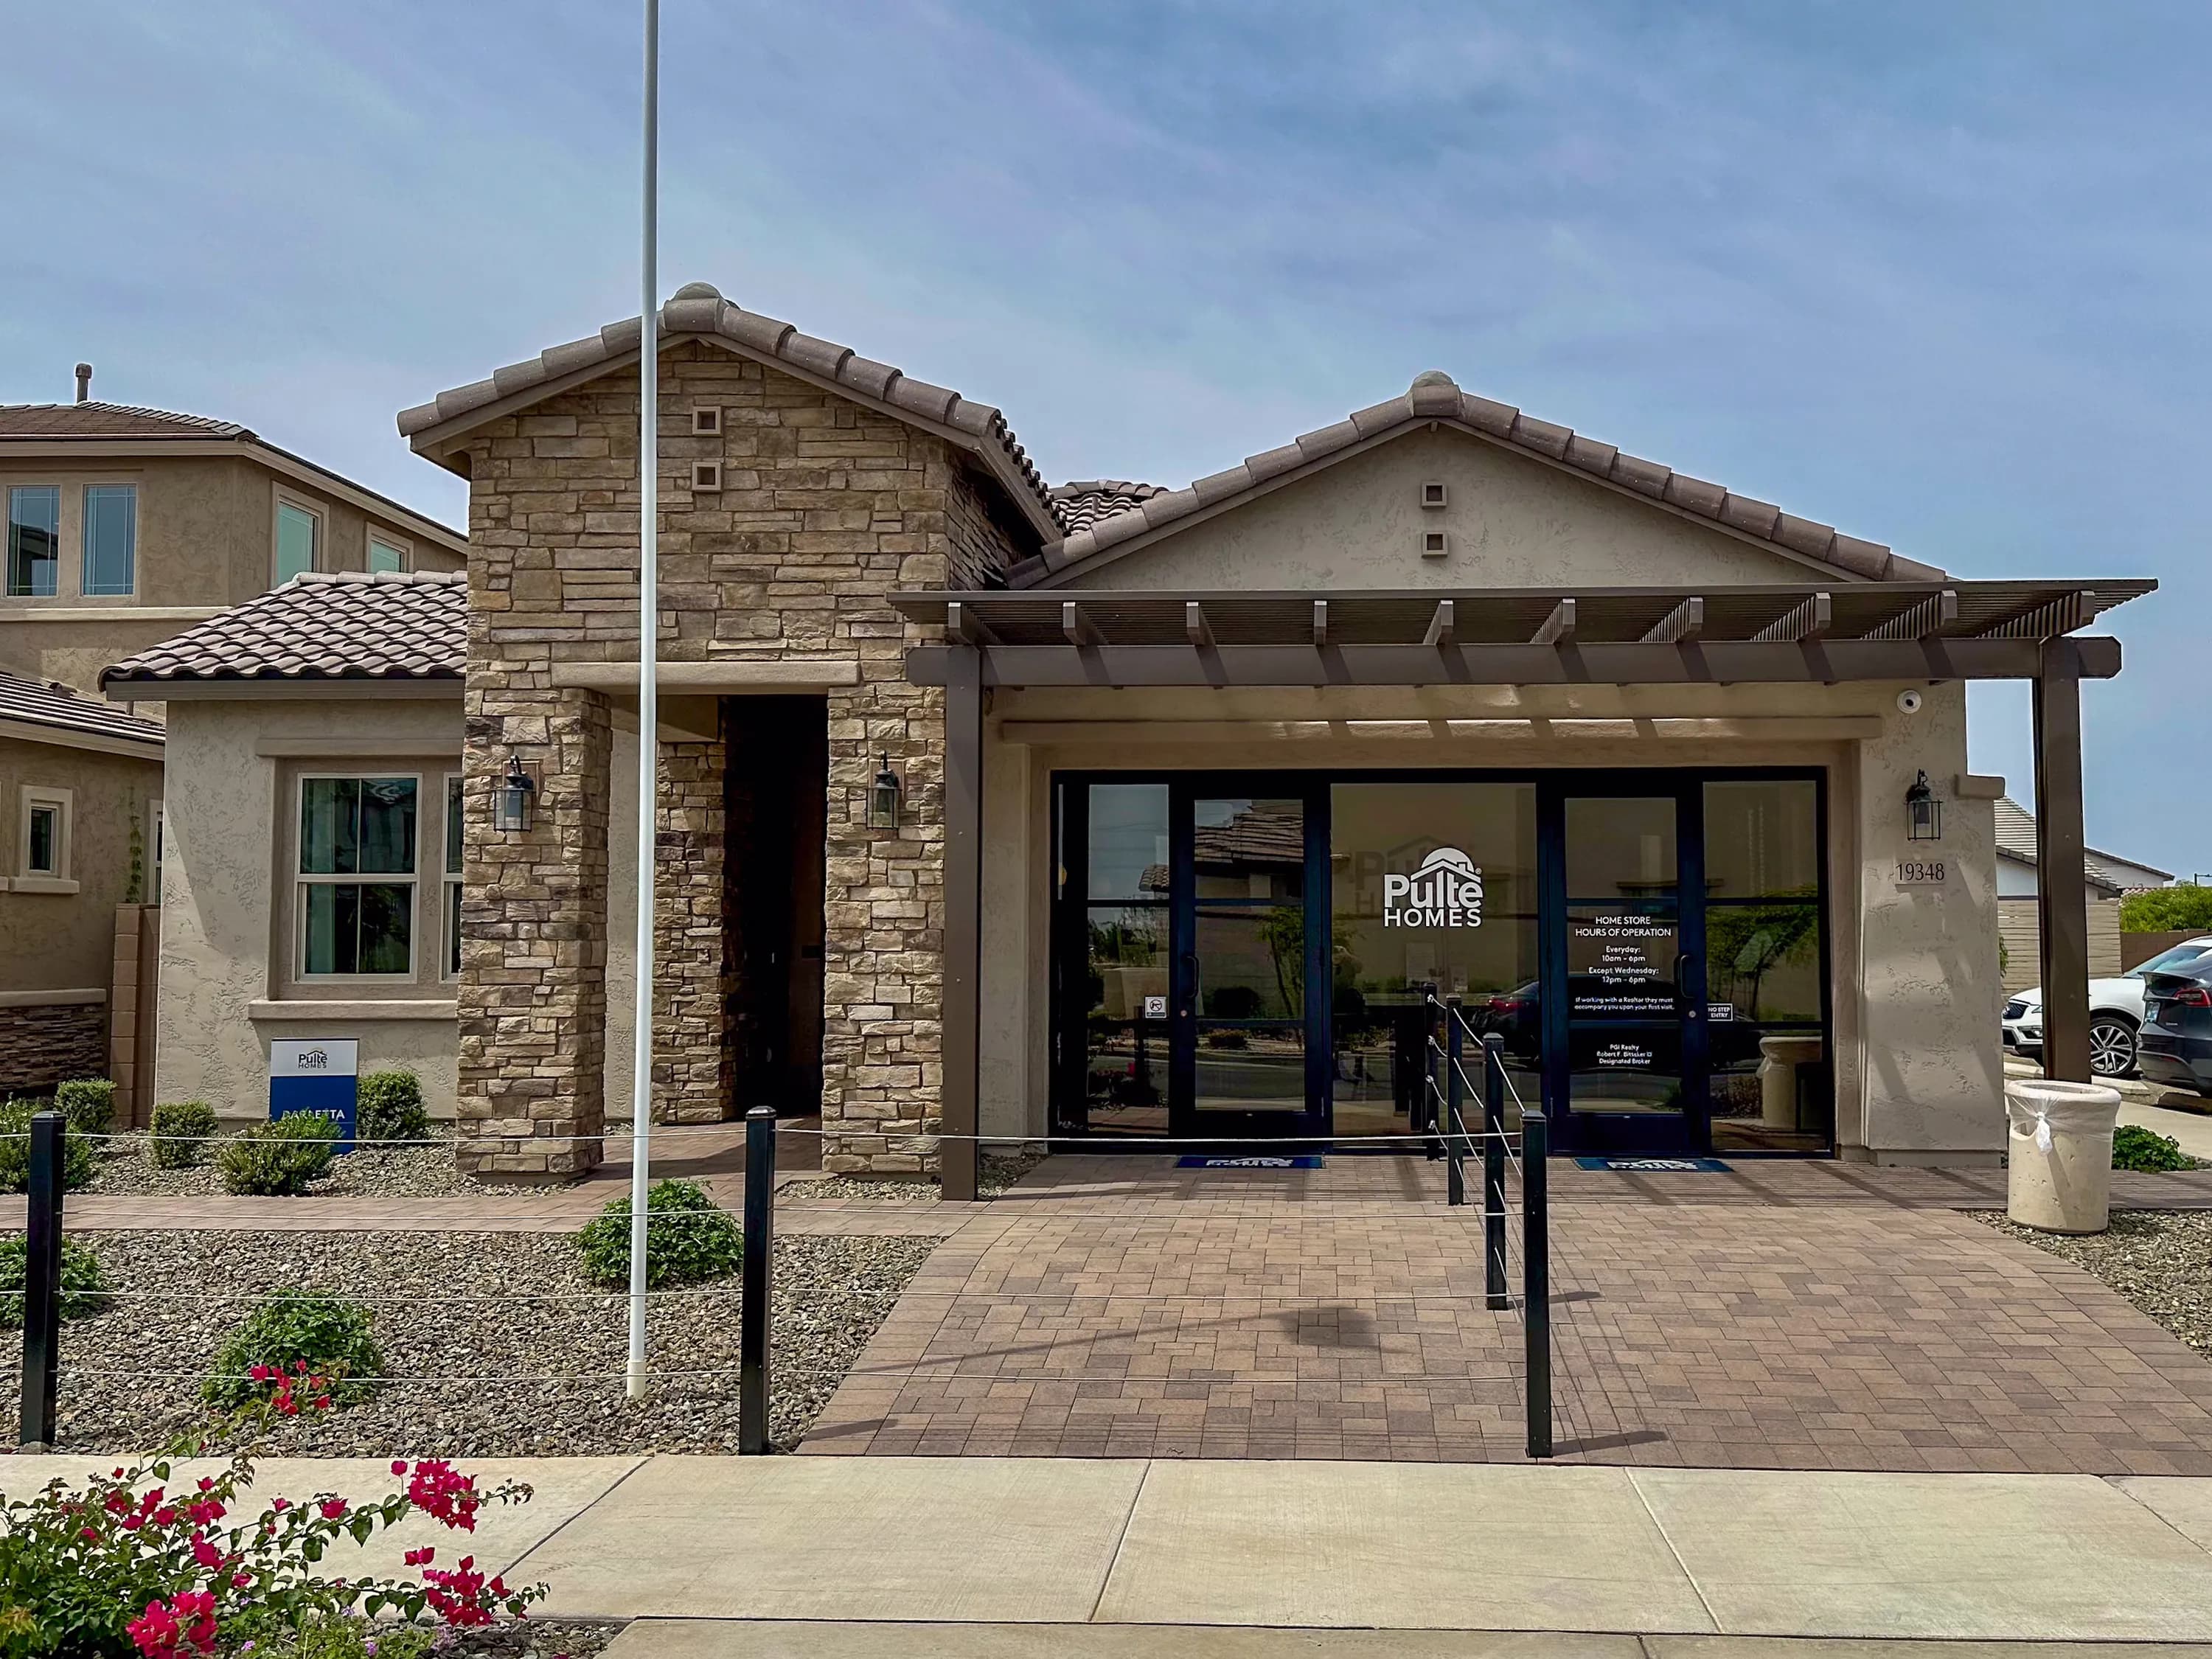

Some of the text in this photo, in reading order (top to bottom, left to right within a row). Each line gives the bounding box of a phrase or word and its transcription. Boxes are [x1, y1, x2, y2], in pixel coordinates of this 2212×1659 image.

[1896, 863, 1944, 880] 19348
[1384, 869, 1484, 908] Pulte
[1384, 908, 1481, 927] HOMES
[1596, 917, 1652, 925] HOME STORE
[1575, 928, 1672, 936] HOURS OF OPERATION
[1606, 945, 1641, 954] Everyday:
[1628, 955, 1646, 963] 6pm
[1588, 967, 1660, 975] Except Wednesday:
[1601, 976, 1622, 984] 12pm
[1628, 976, 1646, 984] 6pm
[299, 1053, 327, 1063] Pulte
